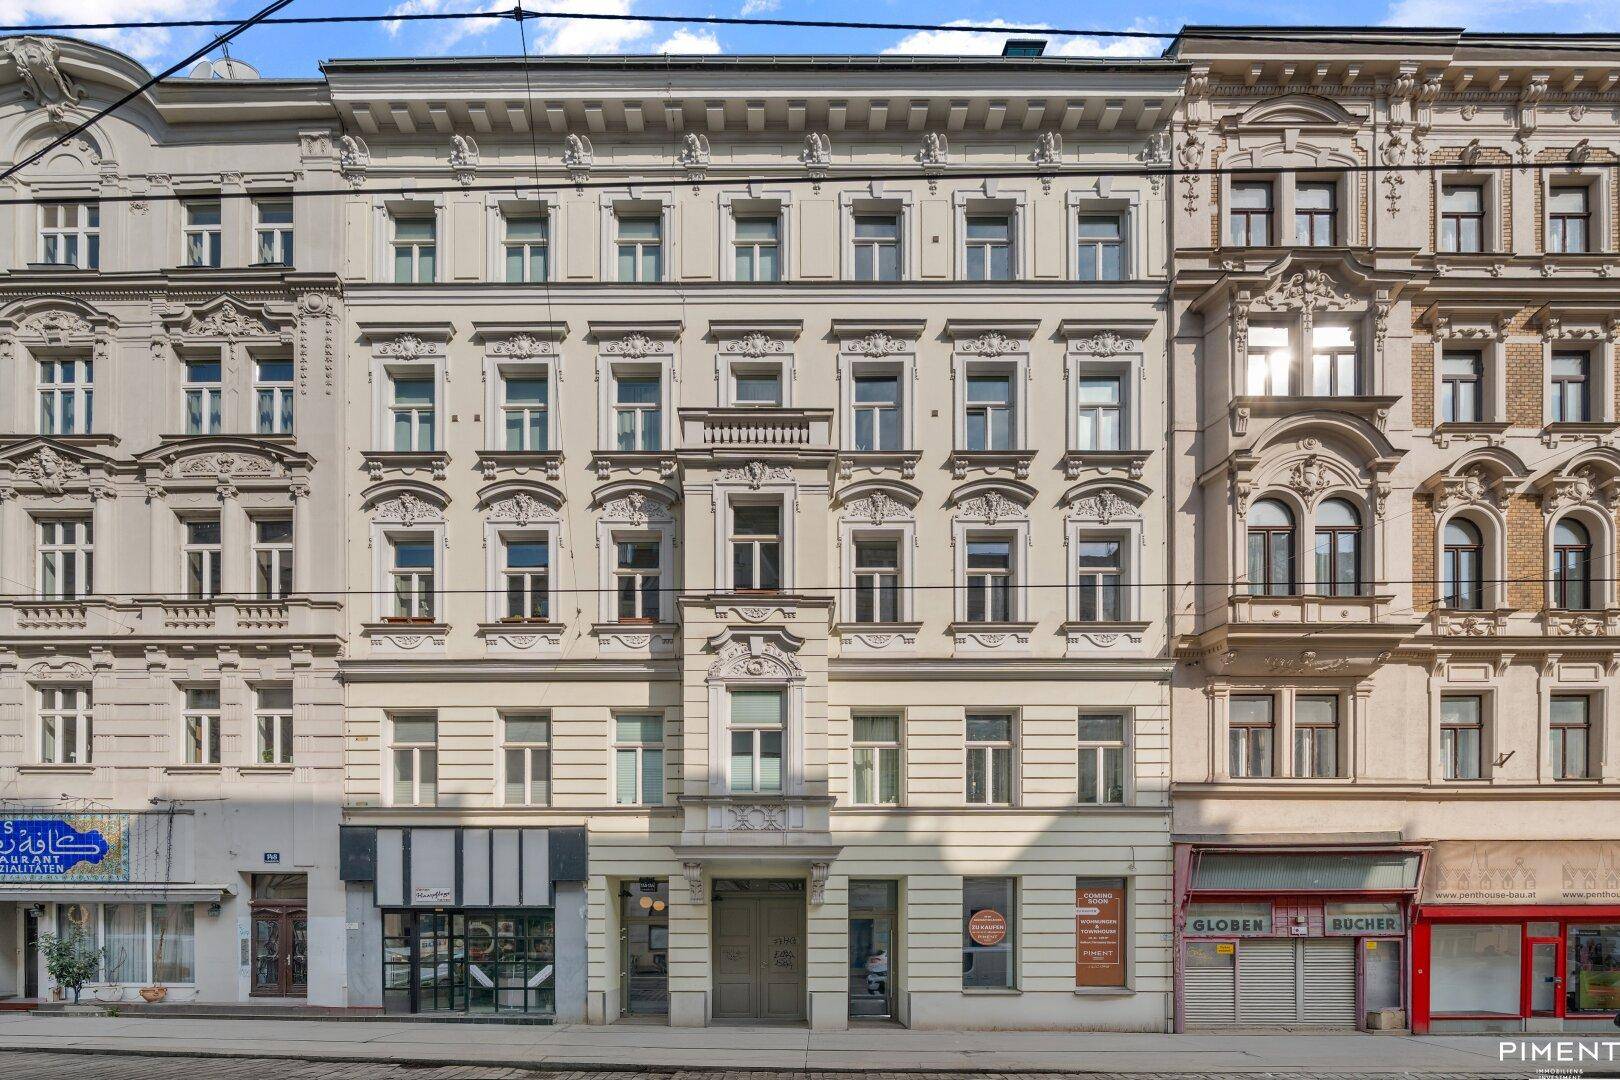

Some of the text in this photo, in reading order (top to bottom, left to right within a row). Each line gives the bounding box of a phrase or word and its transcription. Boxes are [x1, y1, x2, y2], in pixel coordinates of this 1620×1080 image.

[1435, 891, 1537, 900] www.penthouse-bau.at
[1192, 919, 1263, 932] GLOBEN
[1332, 917, 1396, 930] BÜCHER
